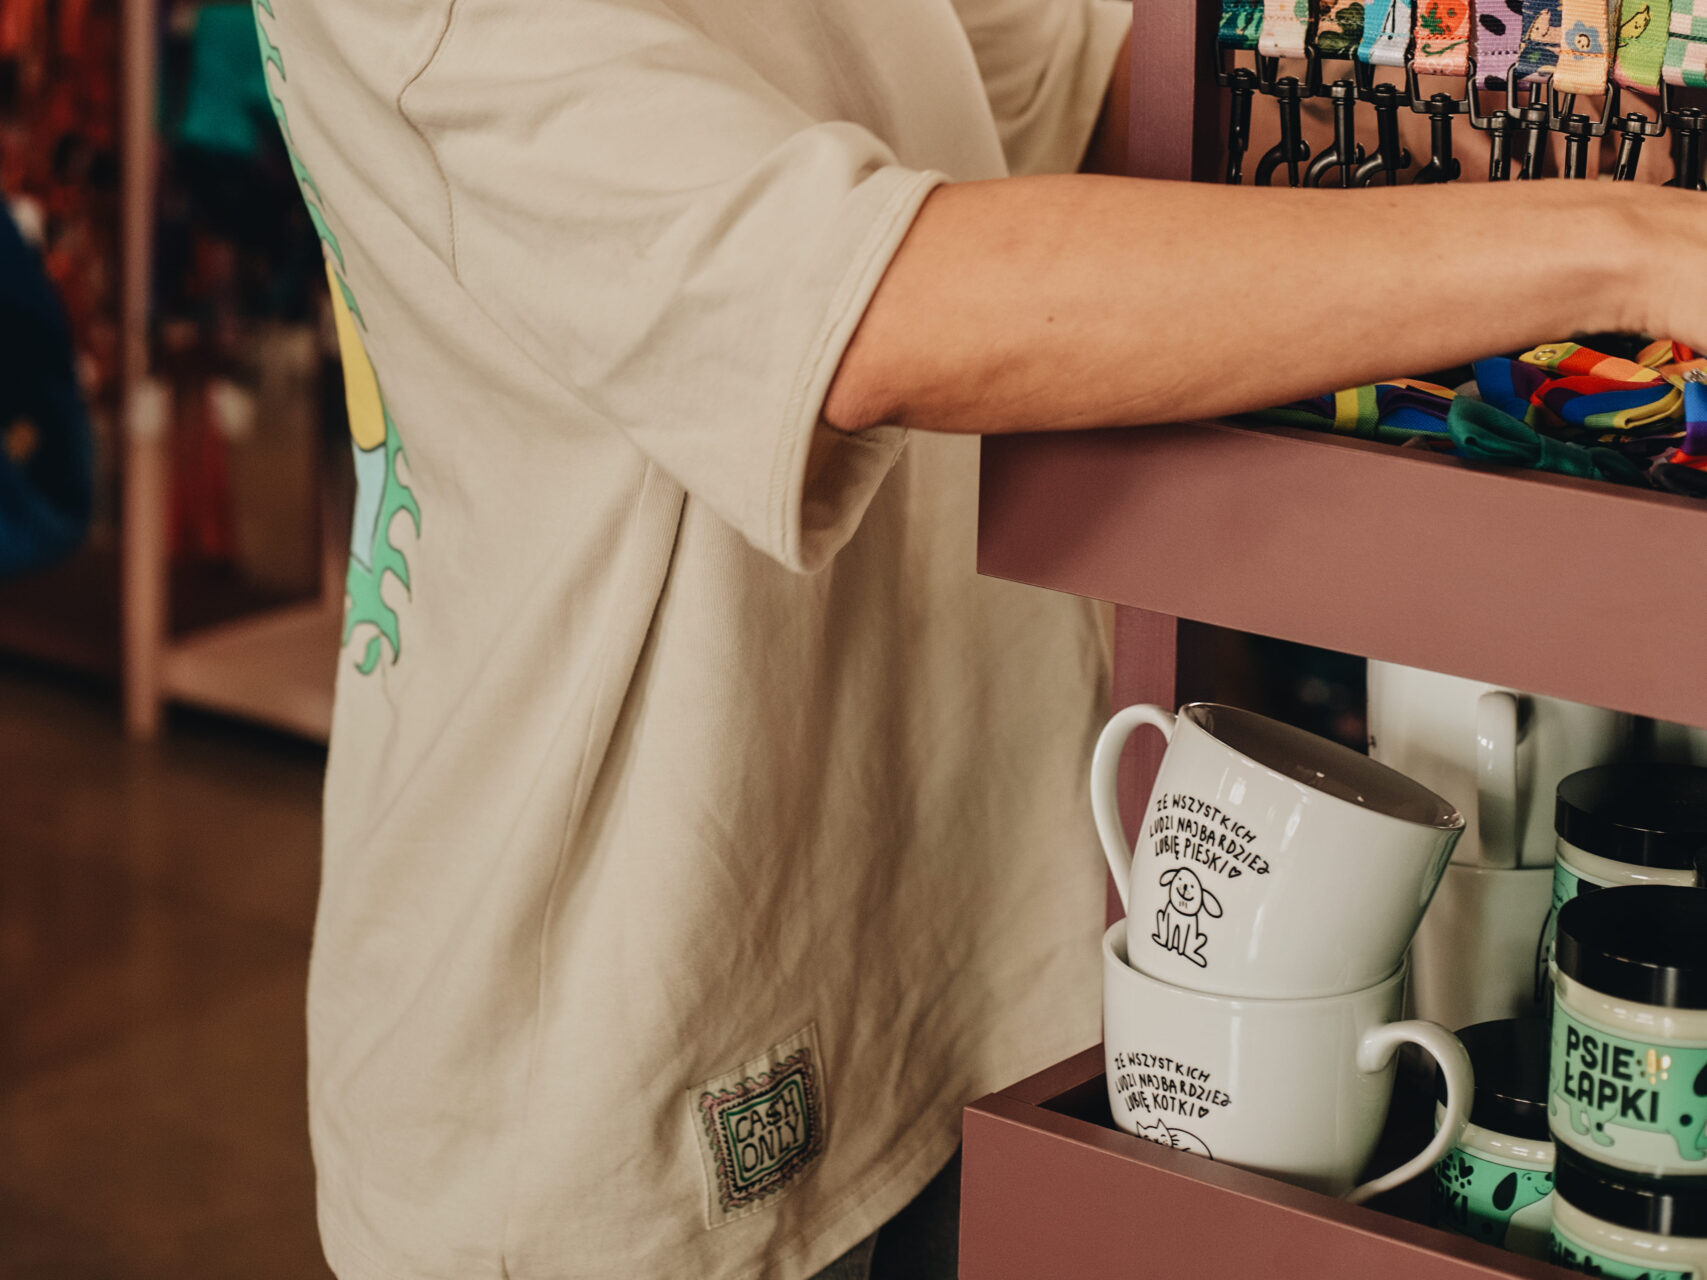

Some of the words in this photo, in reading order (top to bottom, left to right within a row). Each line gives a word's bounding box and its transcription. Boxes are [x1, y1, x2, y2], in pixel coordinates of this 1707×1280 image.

[1172, 793, 1257, 844] WSZYSTKICH
[1176, 817, 1270, 875] NAJBARDZIEJ
[1183, 837, 1229, 874] PIESKI
[1127, 1052, 1211, 1083] WSZYSTKICH
[1565, 1024, 1635, 1082] PSIE
[736, 1087, 800, 1143] CASH
[1139, 1073, 1232, 1107] NAJBARDZIEJ
[1152, 1092, 1195, 1117] KOTKI
[1564, 1061, 1660, 1124] ŁAPKI
[742, 1111, 799, 1173] ONLY
